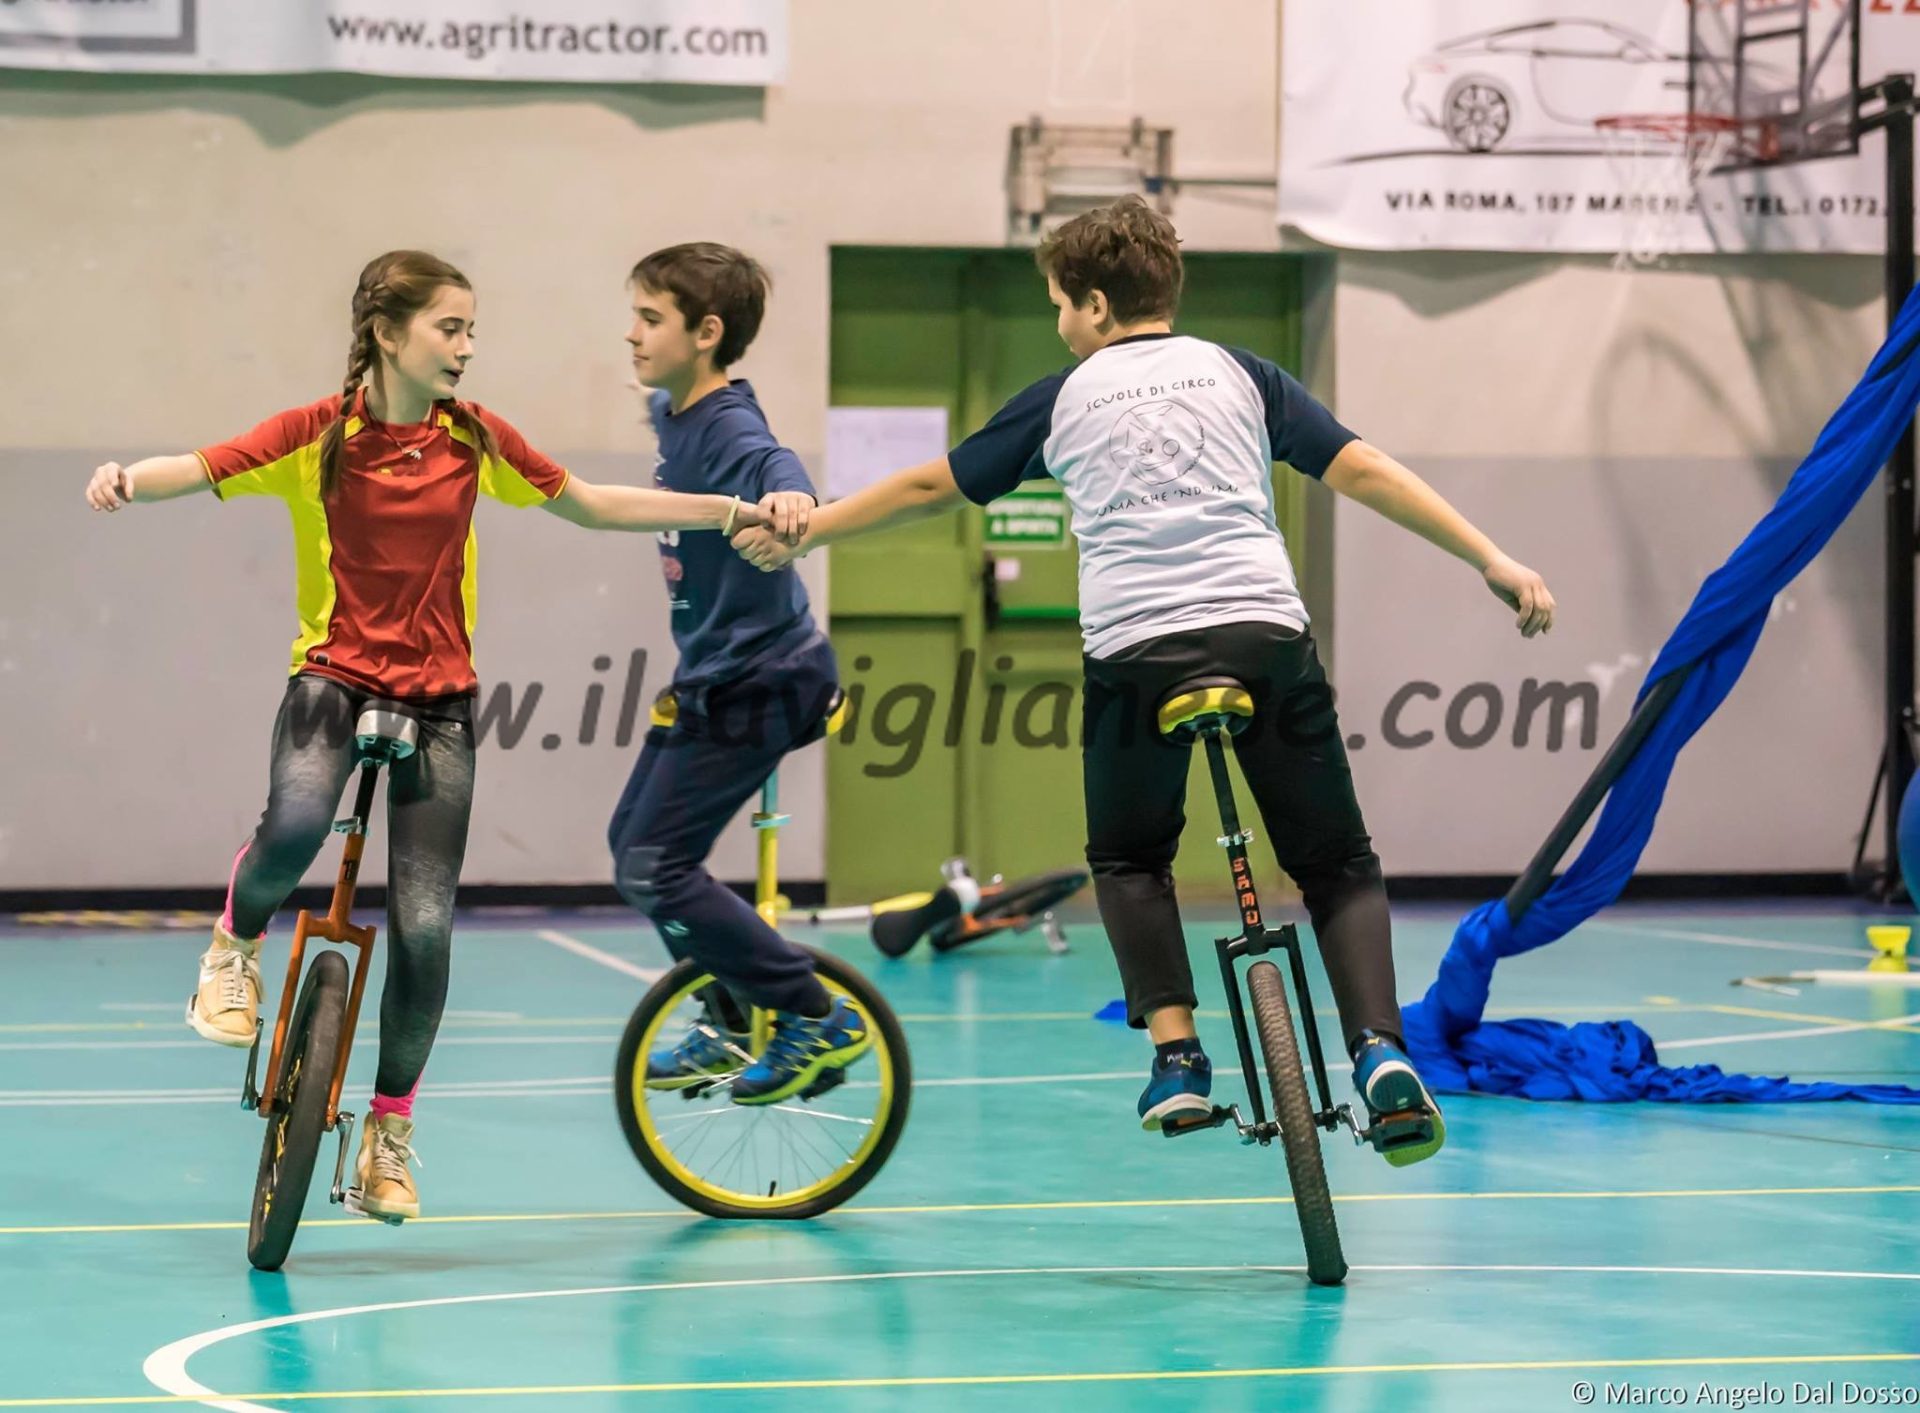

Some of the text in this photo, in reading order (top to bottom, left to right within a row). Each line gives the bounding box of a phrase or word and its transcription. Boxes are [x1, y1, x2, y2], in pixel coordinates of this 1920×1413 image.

[327, 15, 769, 59] www.agritractor.com
[1384, 190, 1434, 212] VIA
[1086, 377, 1216, 413] SCUOLE DI CIRCO
[1141, 492, 1167, 505] CHE
